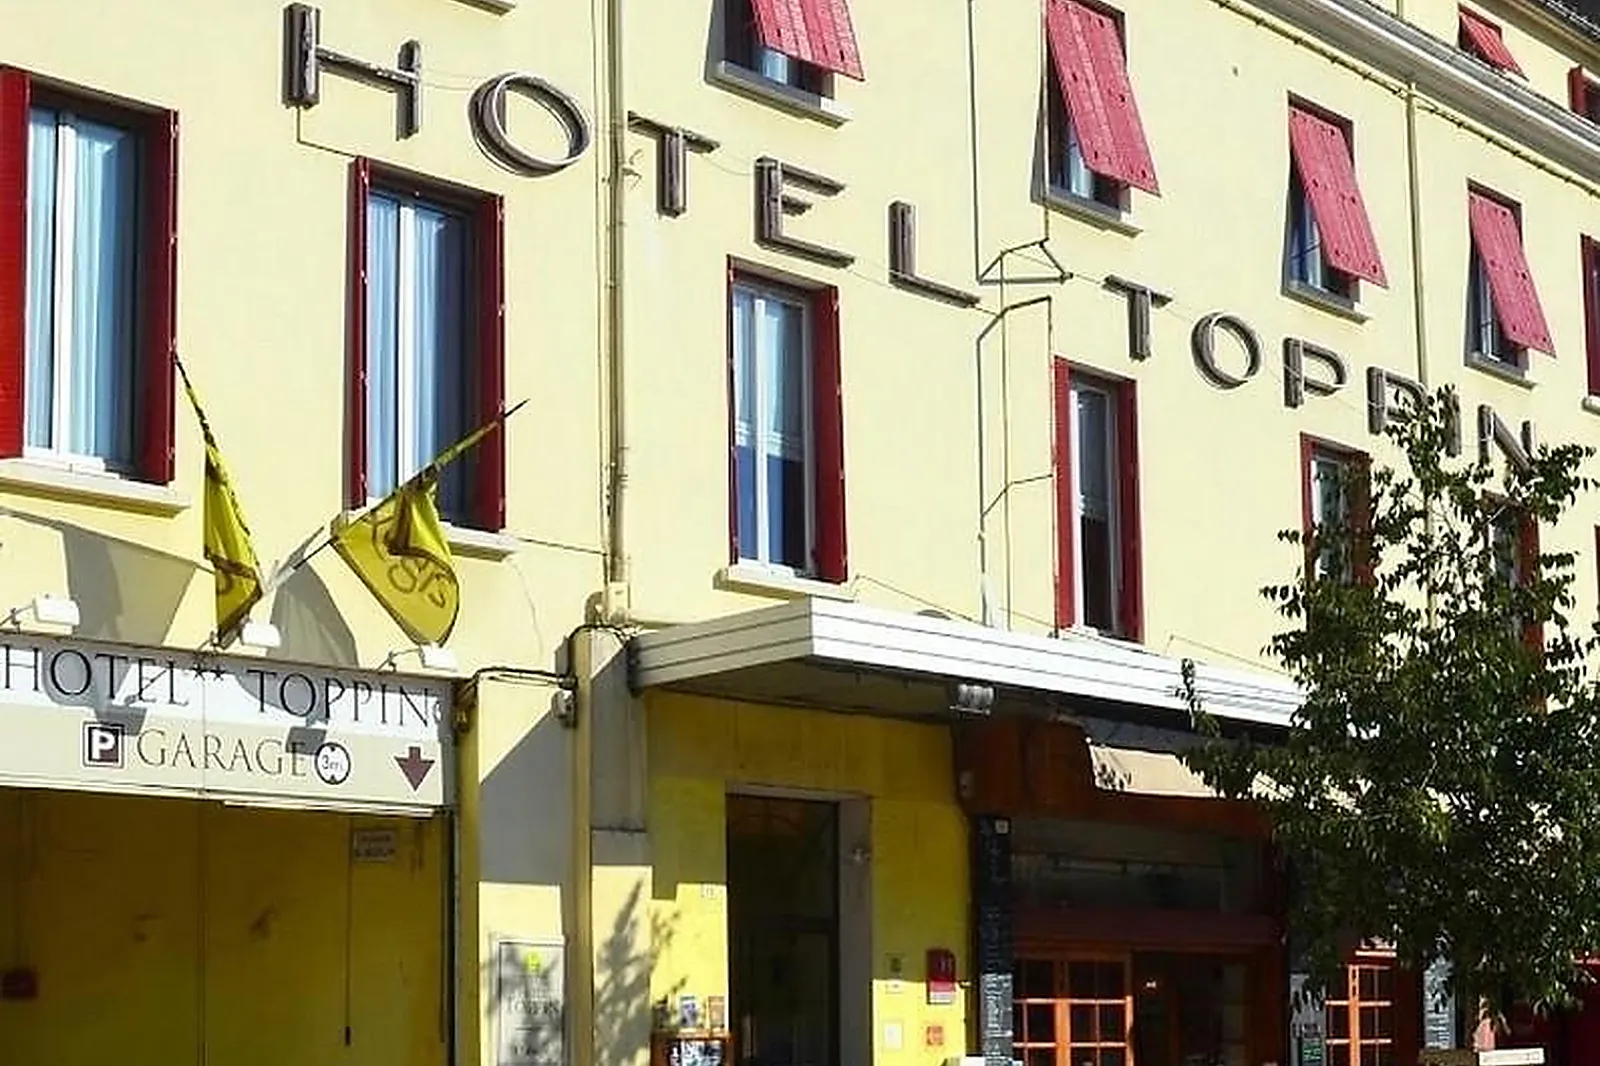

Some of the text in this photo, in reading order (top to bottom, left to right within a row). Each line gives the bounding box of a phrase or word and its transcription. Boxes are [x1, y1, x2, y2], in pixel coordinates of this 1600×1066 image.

[281, 2, 1546, 489] HOTEL TOPPIN
[1, 644, 190, 706] HOTEL
[137, 728, 307, 777] GARAGE
